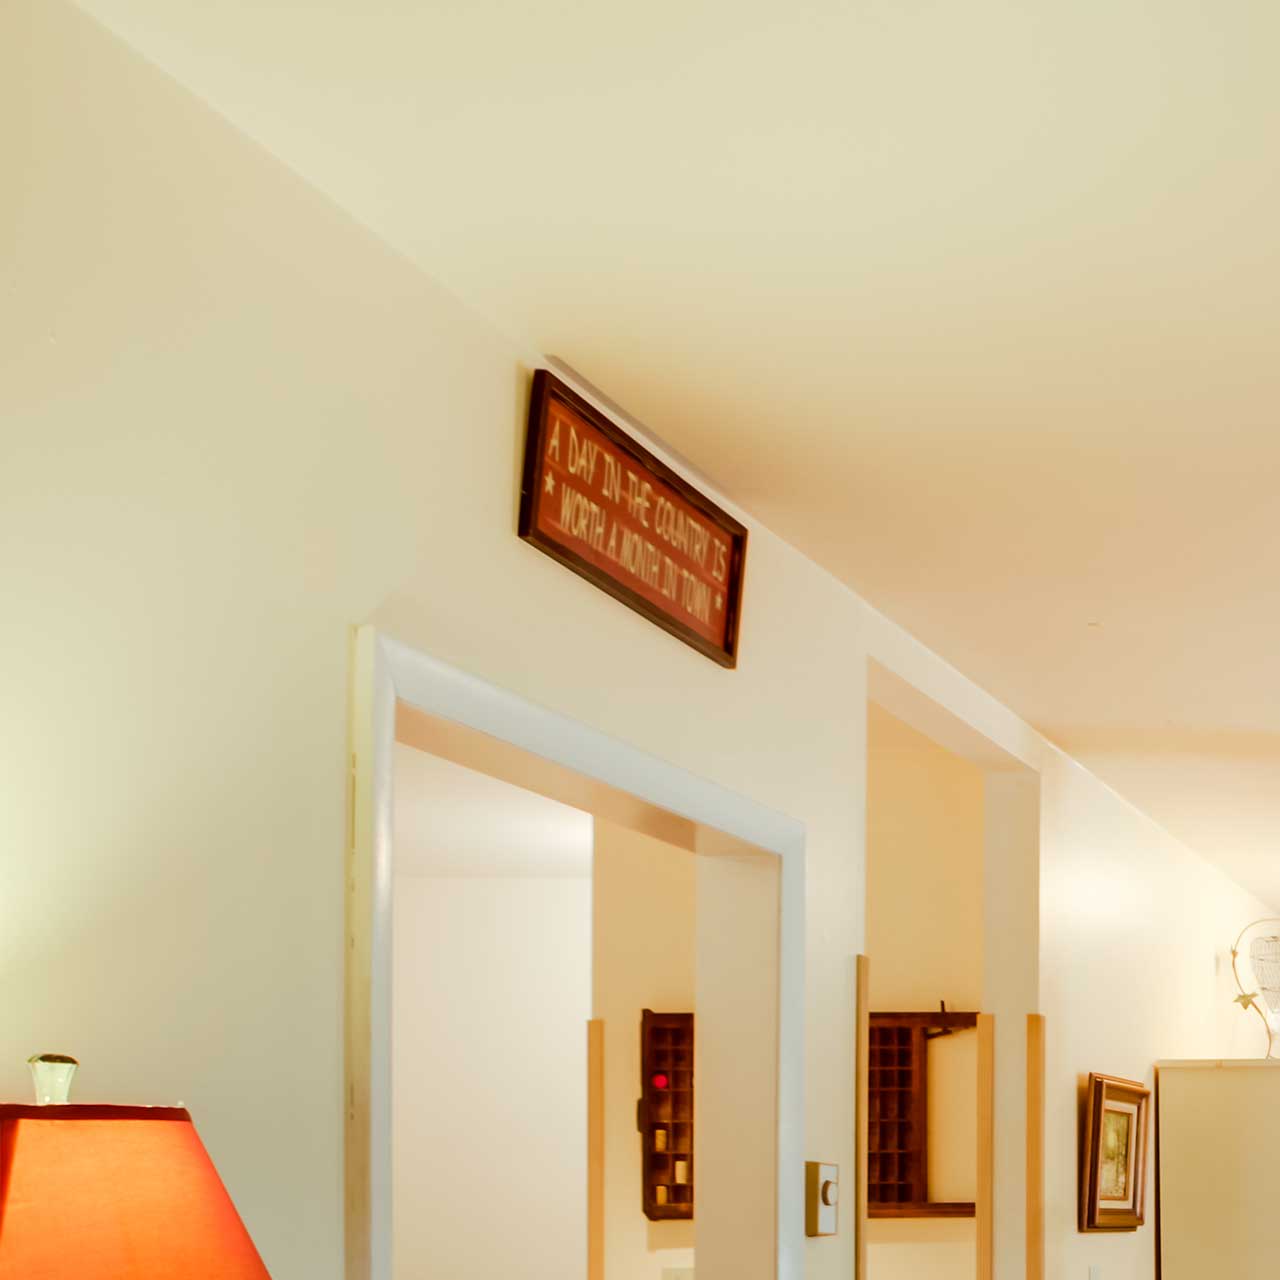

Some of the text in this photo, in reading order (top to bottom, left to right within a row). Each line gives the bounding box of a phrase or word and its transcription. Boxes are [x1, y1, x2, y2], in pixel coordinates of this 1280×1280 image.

[549, 419, 728, 583] A DAY IN THE COUNTRY IS
[560, 483, 711, 625] WORTH A MONTH IN TOWN
